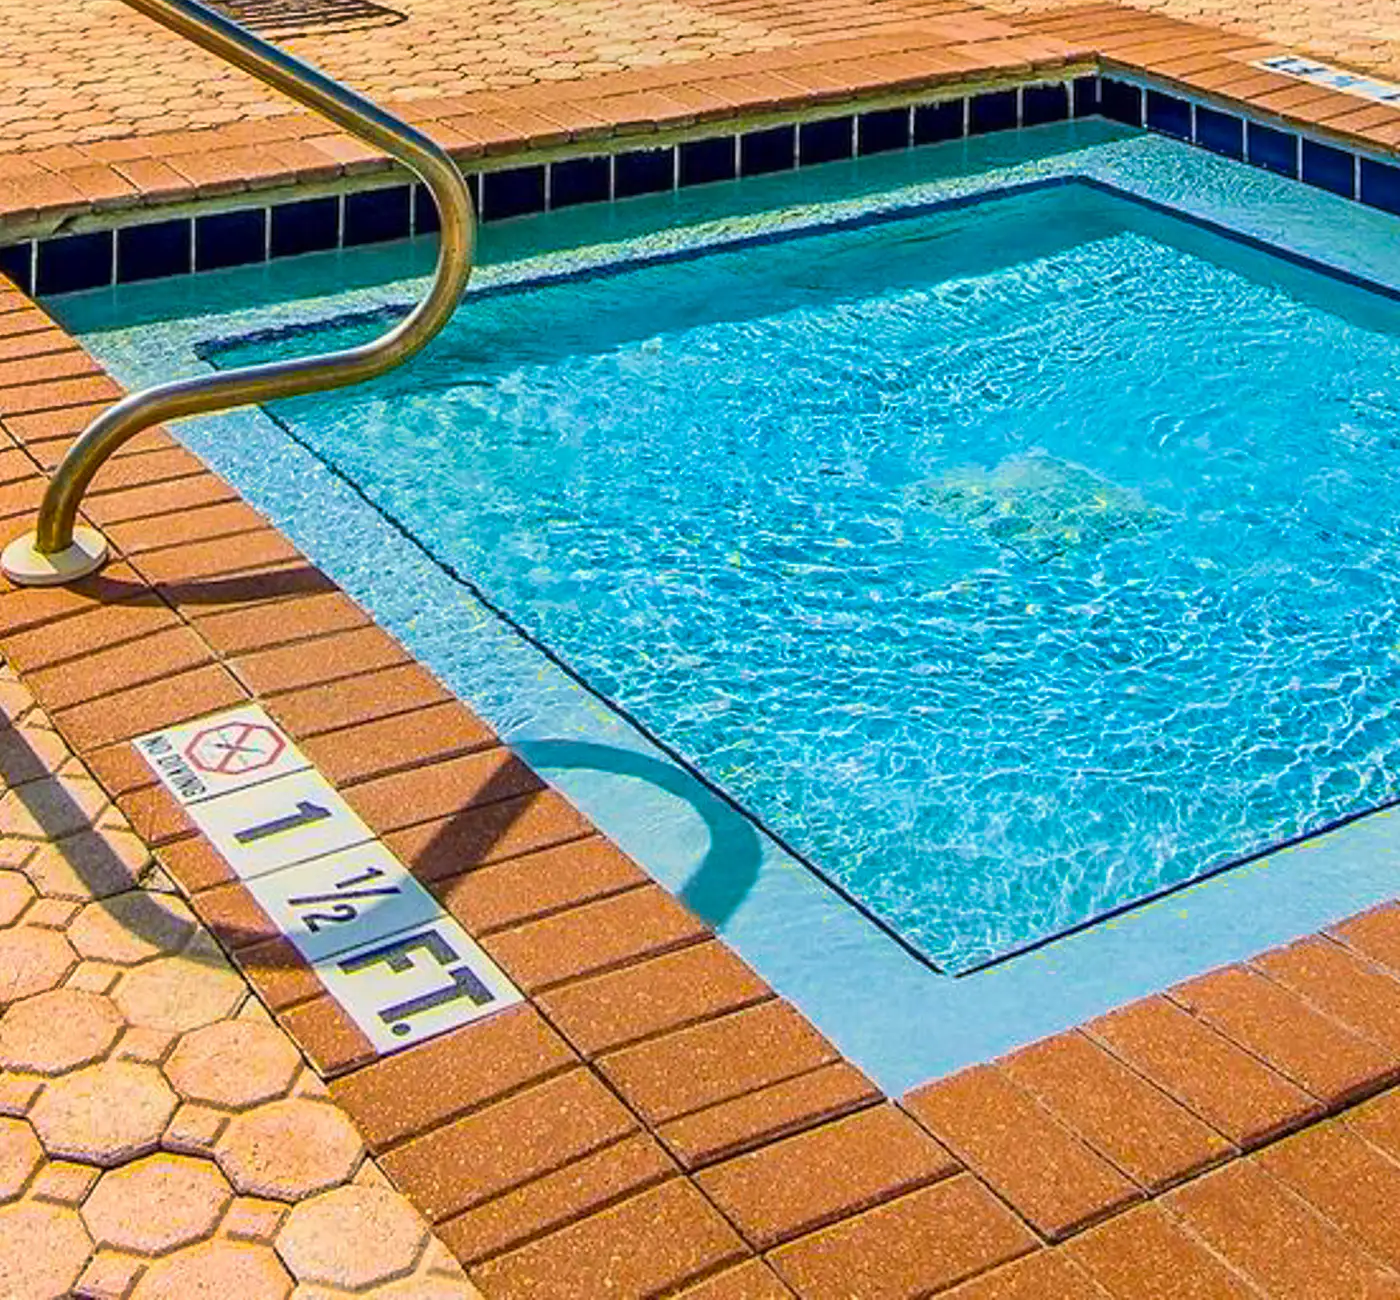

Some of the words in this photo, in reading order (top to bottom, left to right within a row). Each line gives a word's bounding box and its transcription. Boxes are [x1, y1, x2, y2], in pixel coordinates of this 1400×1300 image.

[141, 735, 173, 754] NO
[157, 753, 207, 797] DIVING
[234, 801, 332, 844] 1
[337, 929, 495, 1035] FT.
